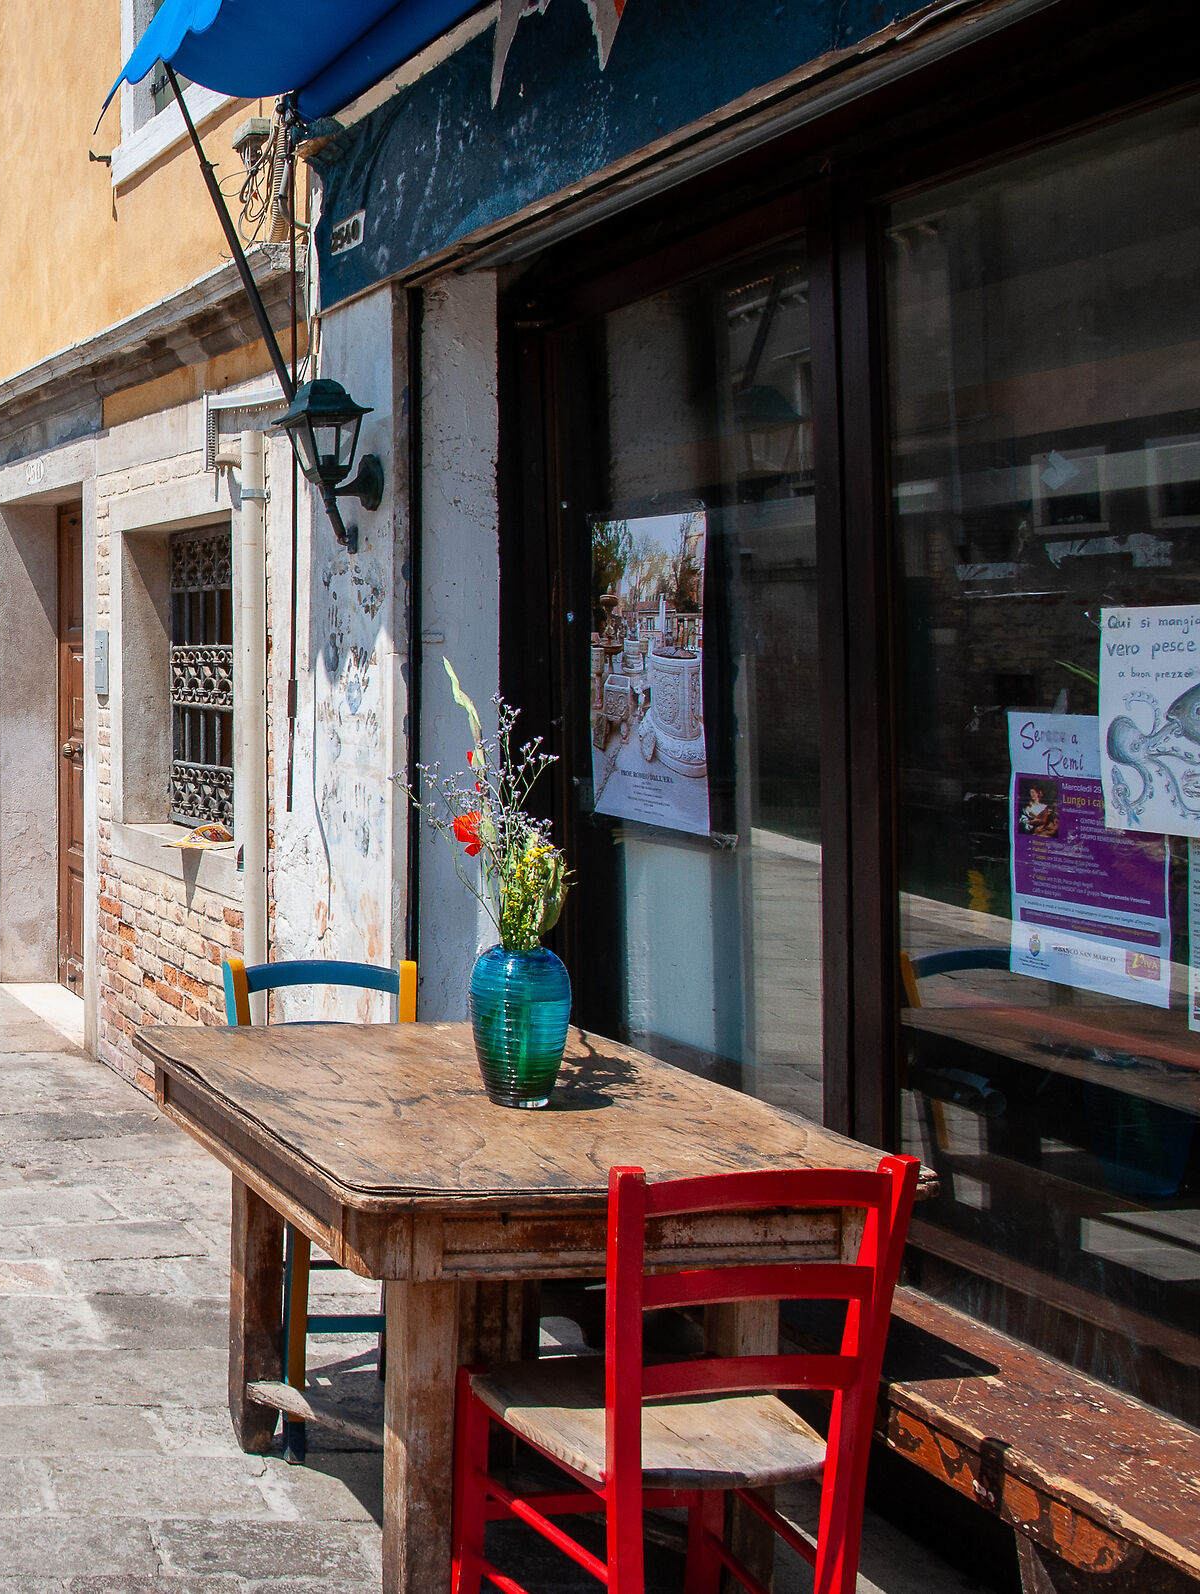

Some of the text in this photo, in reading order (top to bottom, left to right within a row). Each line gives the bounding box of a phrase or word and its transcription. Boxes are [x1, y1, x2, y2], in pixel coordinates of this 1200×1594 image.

[1107, 615, 1131, 629] Qui
[1140, 617, 1150, 628] si
[1106, 641, 1197, 660] vero pesce
[1130, 666, 1151, 678] buon
[1042, 748, 1084, 778] Remi
[1062, 794, 1086, 808] Lungo
[1093, 953, 1116, 963] MARCO
